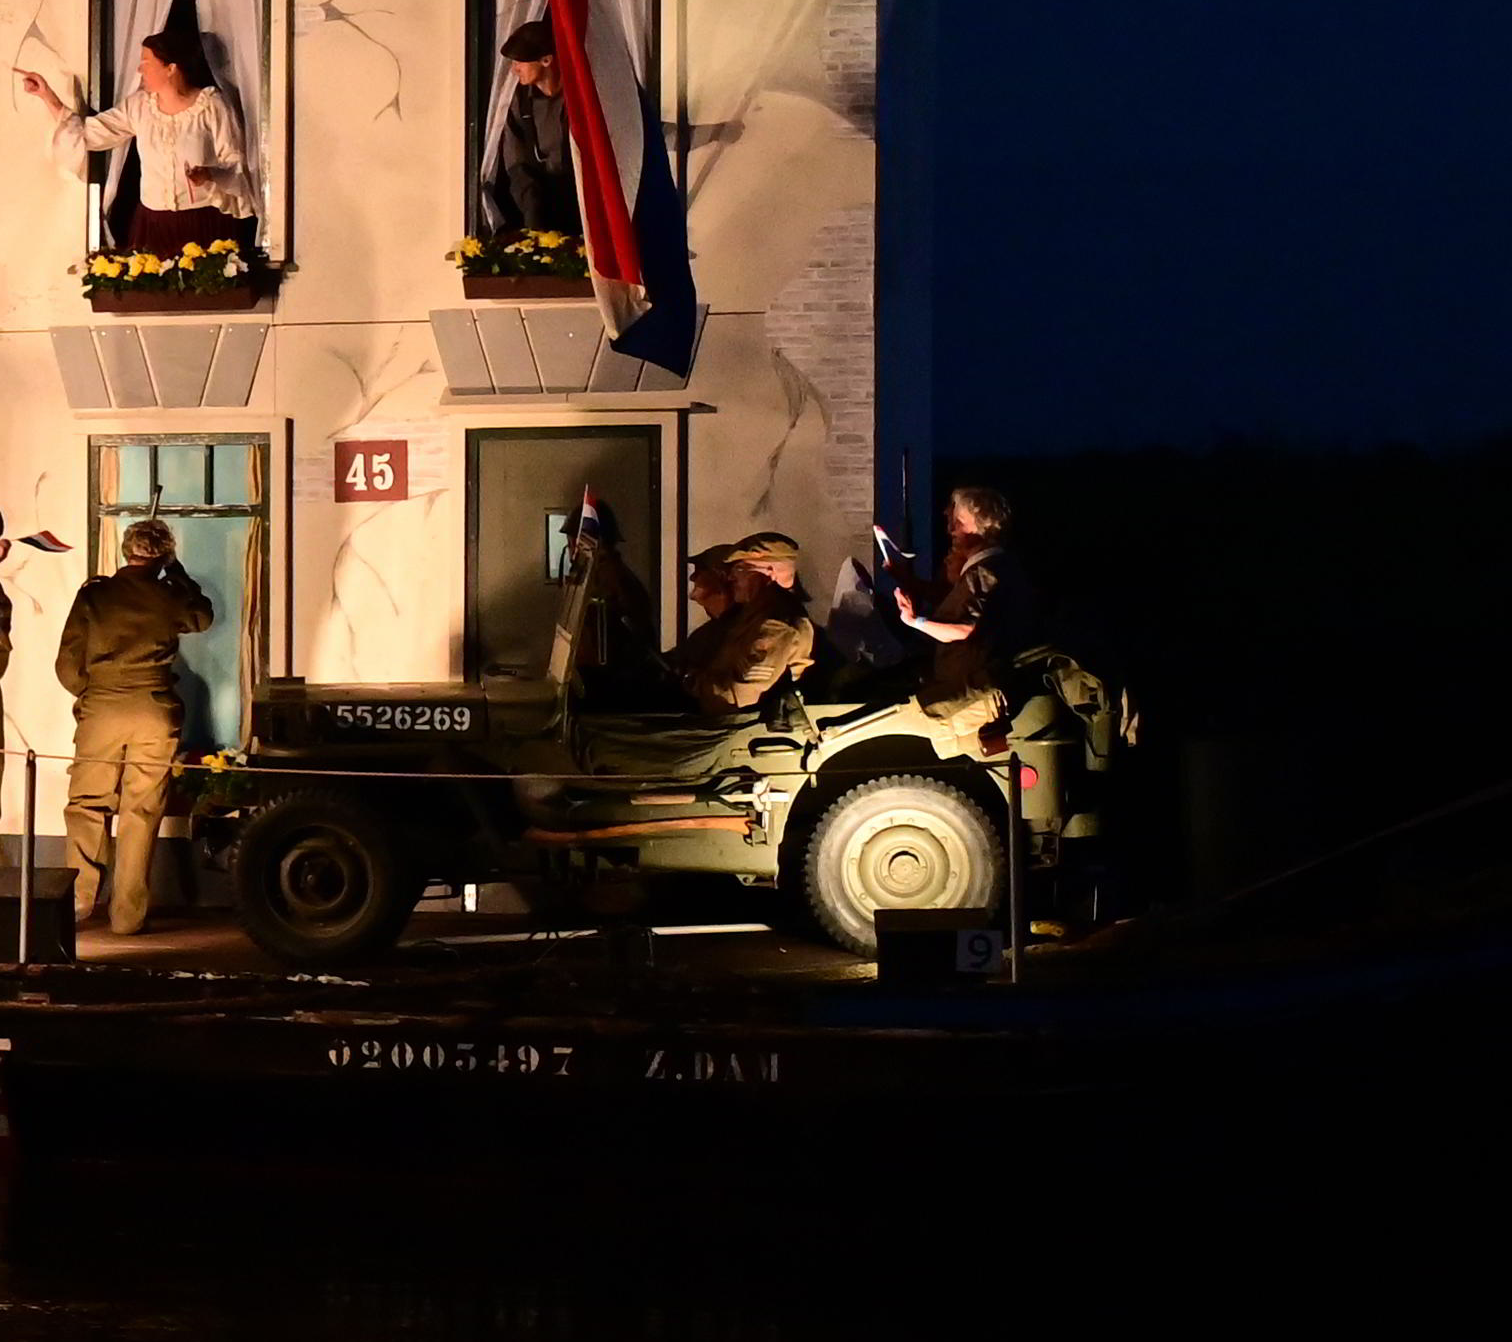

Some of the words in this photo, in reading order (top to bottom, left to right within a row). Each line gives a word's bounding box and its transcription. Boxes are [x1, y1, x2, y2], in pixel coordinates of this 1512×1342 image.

[345, 452, 395, 491] 45
[325, 704, 471, 731] 5526269
[967, 932, 993, 969] 9
